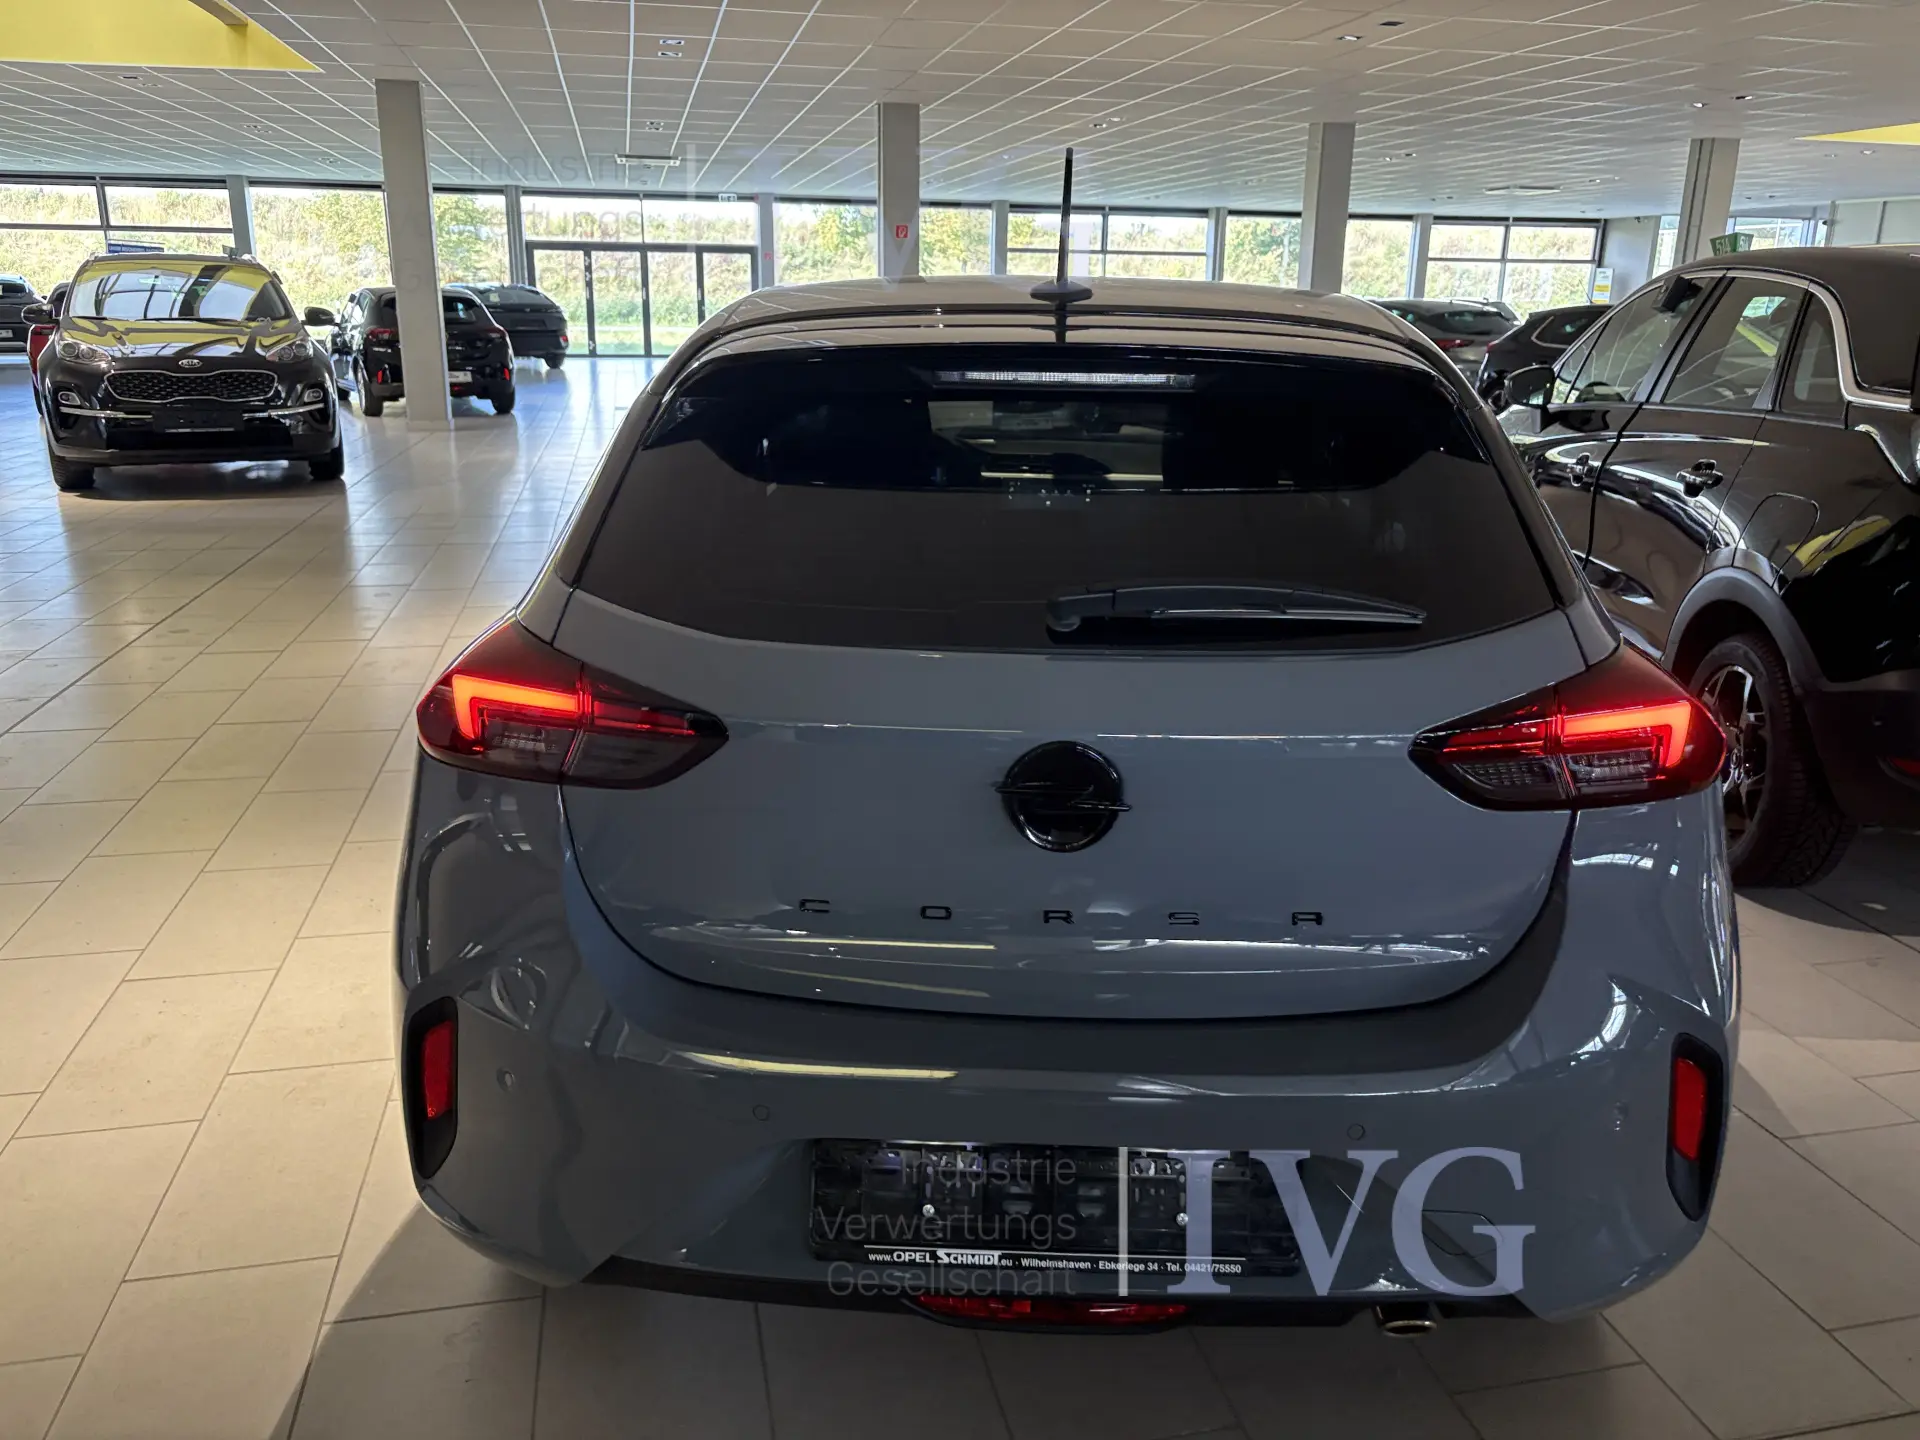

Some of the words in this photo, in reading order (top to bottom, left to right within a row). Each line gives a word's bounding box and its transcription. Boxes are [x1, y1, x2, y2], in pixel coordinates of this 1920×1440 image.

[800, 898, 1324, 927] CORSA
[1020, 1257, 1092, 1270] Wilhelmshaven
[1147, 1262, 1159, 1271] 34
[1166, 1262, 1183, 1272] Tel.
